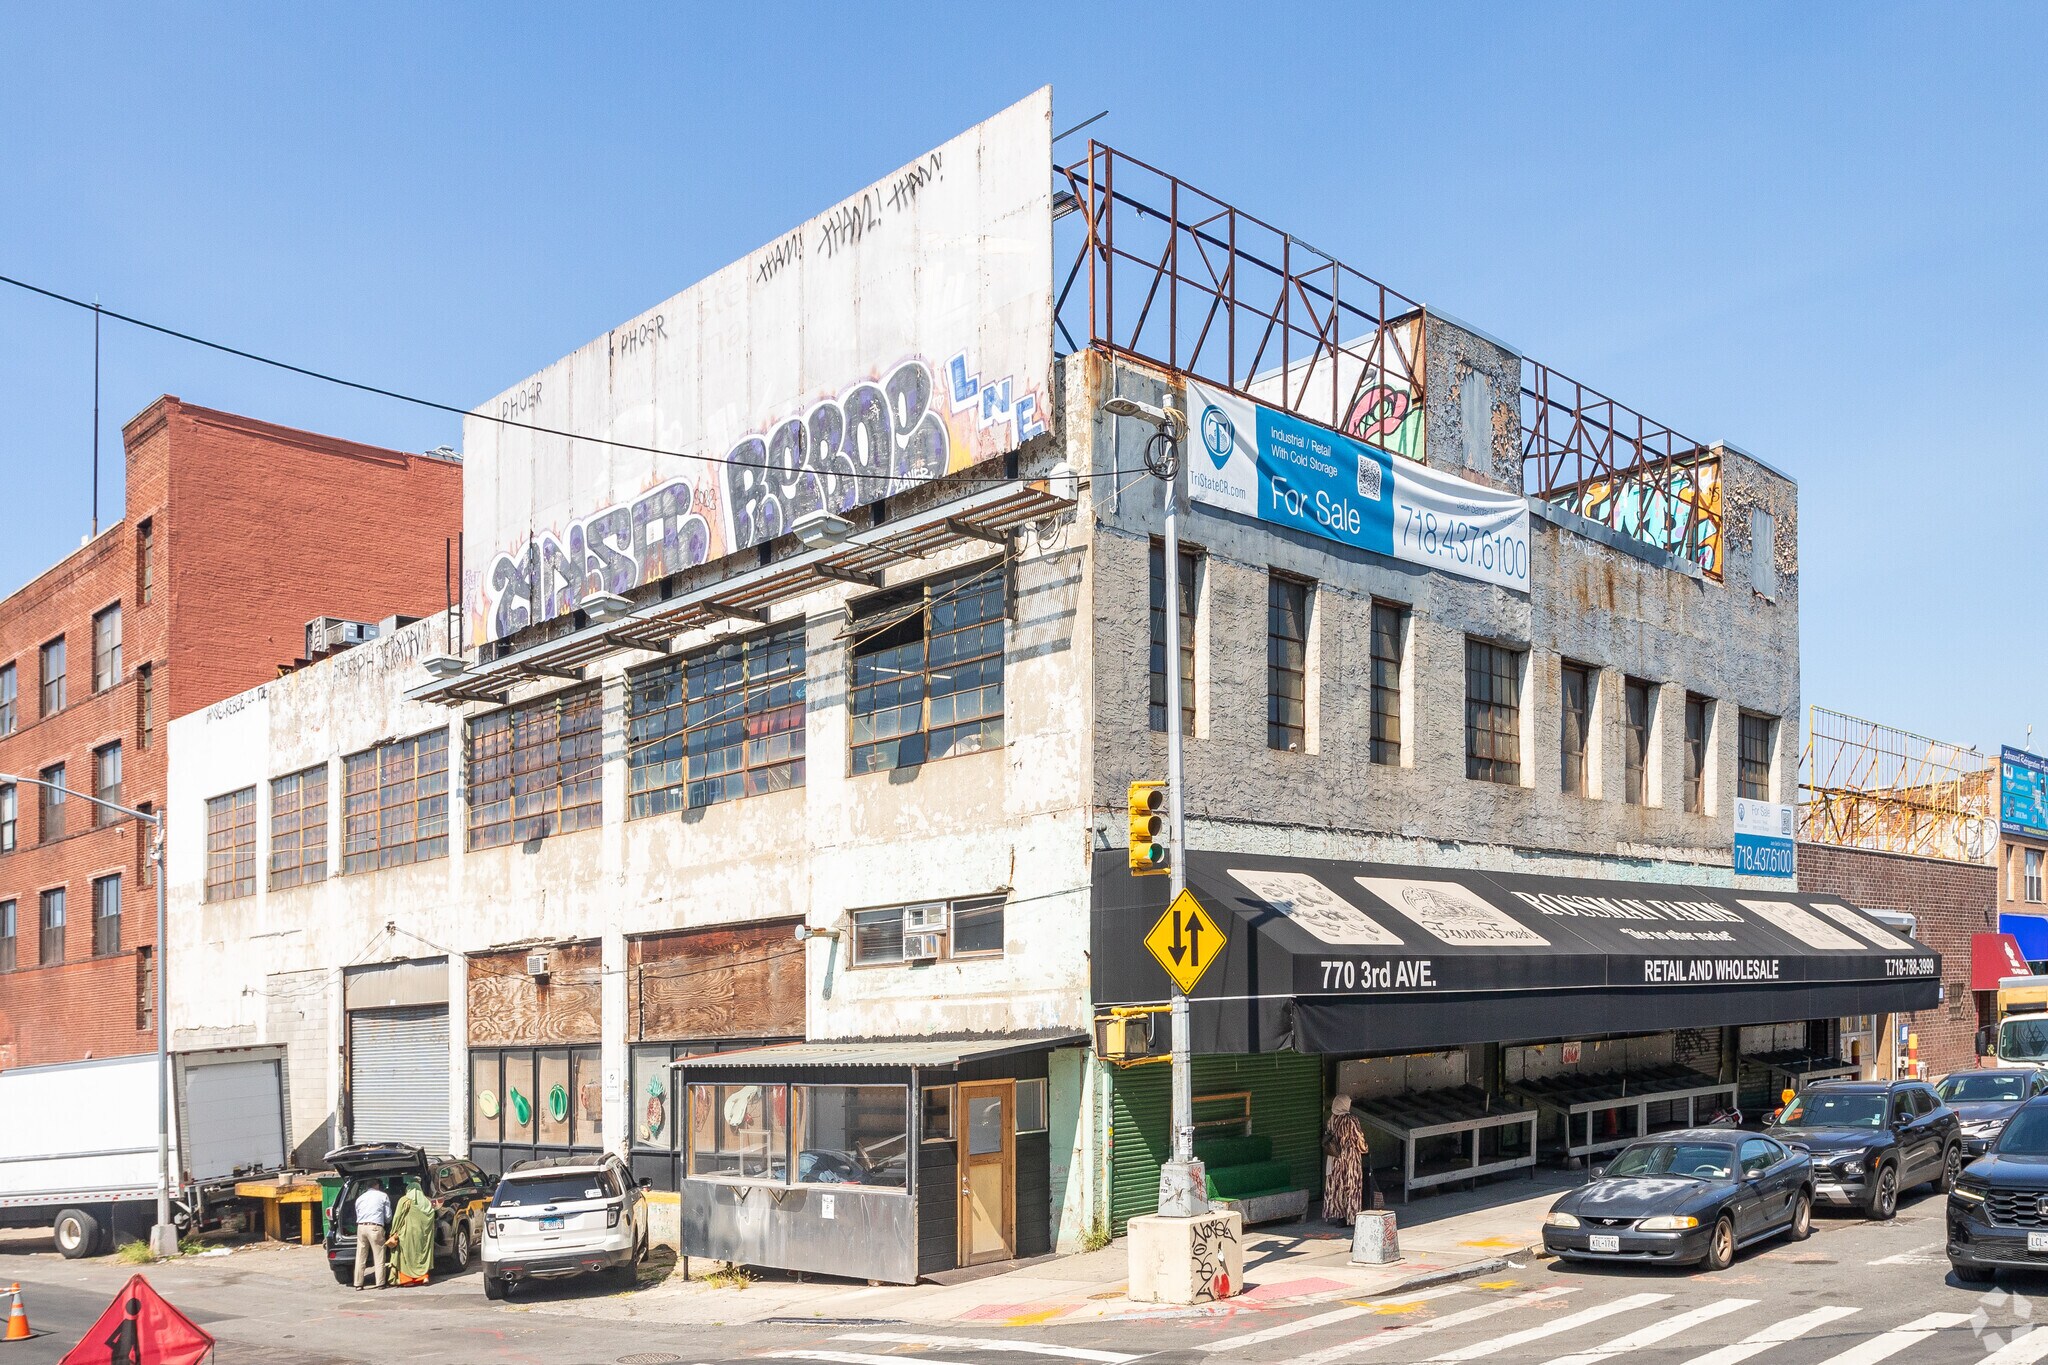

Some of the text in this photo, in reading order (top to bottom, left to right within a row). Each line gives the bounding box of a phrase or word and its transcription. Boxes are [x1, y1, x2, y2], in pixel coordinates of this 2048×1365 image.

[1271, 426, 1305, 448] Industrial
[1311, 440, 1331, 457] Retail
[1271, 444, 1338, 477] With Cold Storage
[1190, 471, 1246, 499] TriStateCR.com
[1271, 475, 1361, 535] For Sale
[1400, 505, 1527, 579] 718.437.6100
[1751, 805, 1771, 817] For Sale
[1736, 845, 1791, 873] 718.437.6100
[1510, 891, 1745, 923] ROSSMAN FARMS
[1320, 961, 1437, 989] 770 3rd AVE.
[1644, 959, 1779, 982] RETAIL AND WHOLESALE
